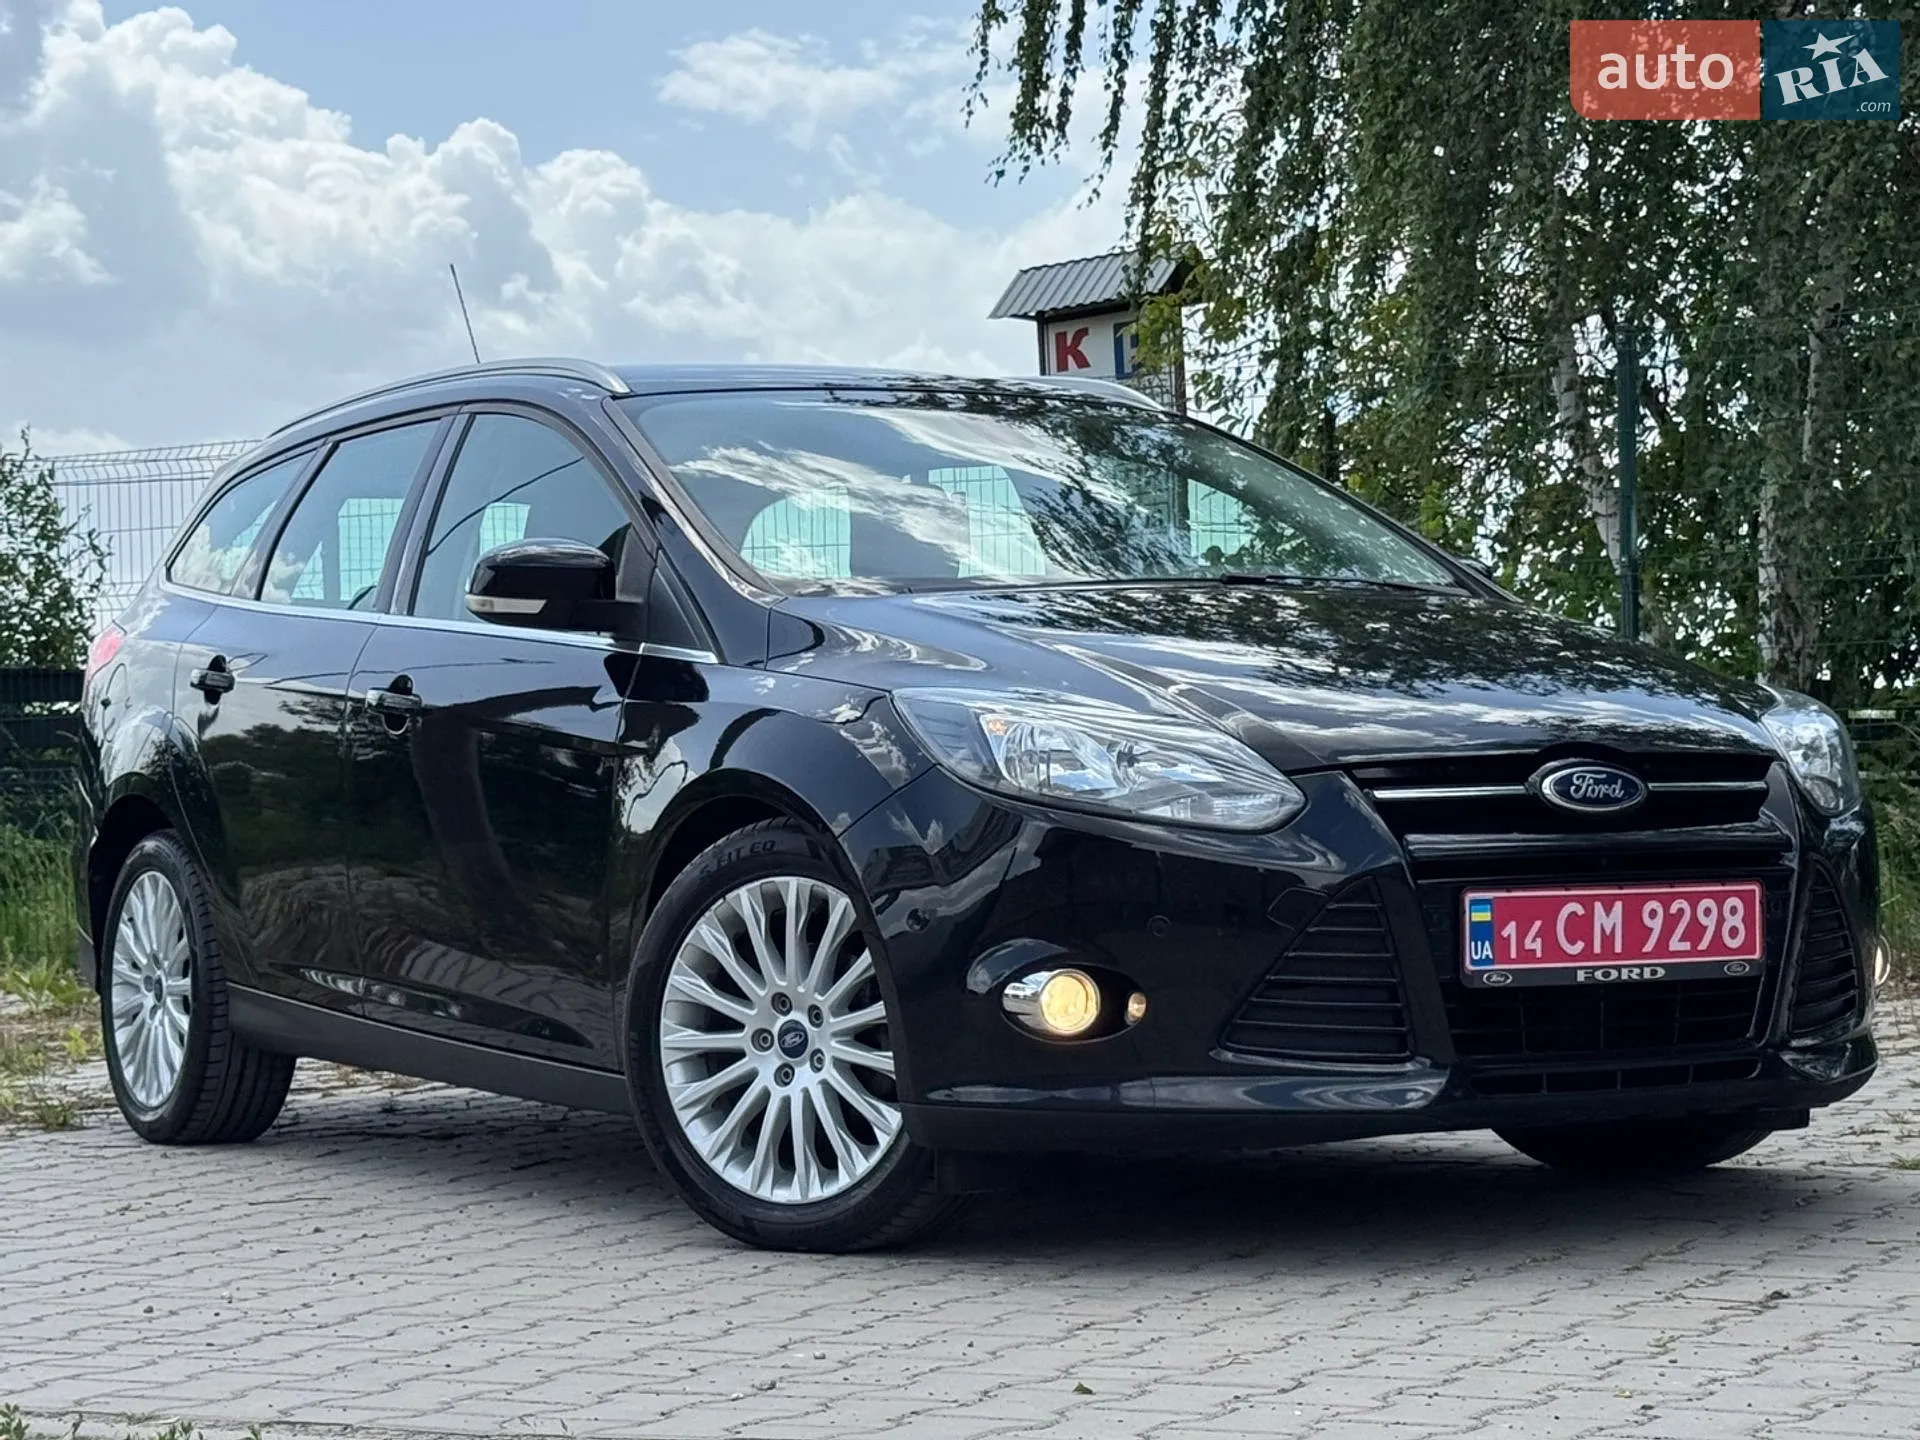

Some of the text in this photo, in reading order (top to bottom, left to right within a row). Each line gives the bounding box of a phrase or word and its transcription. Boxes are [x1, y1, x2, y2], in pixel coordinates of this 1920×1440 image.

[1570, 772, 1624, 799] Ford
[1500, 896, 1746, 959] 14 CM 9298
[1471, 940, 1493, 960] UA
[1576, 966, 1666, 983] FORD
